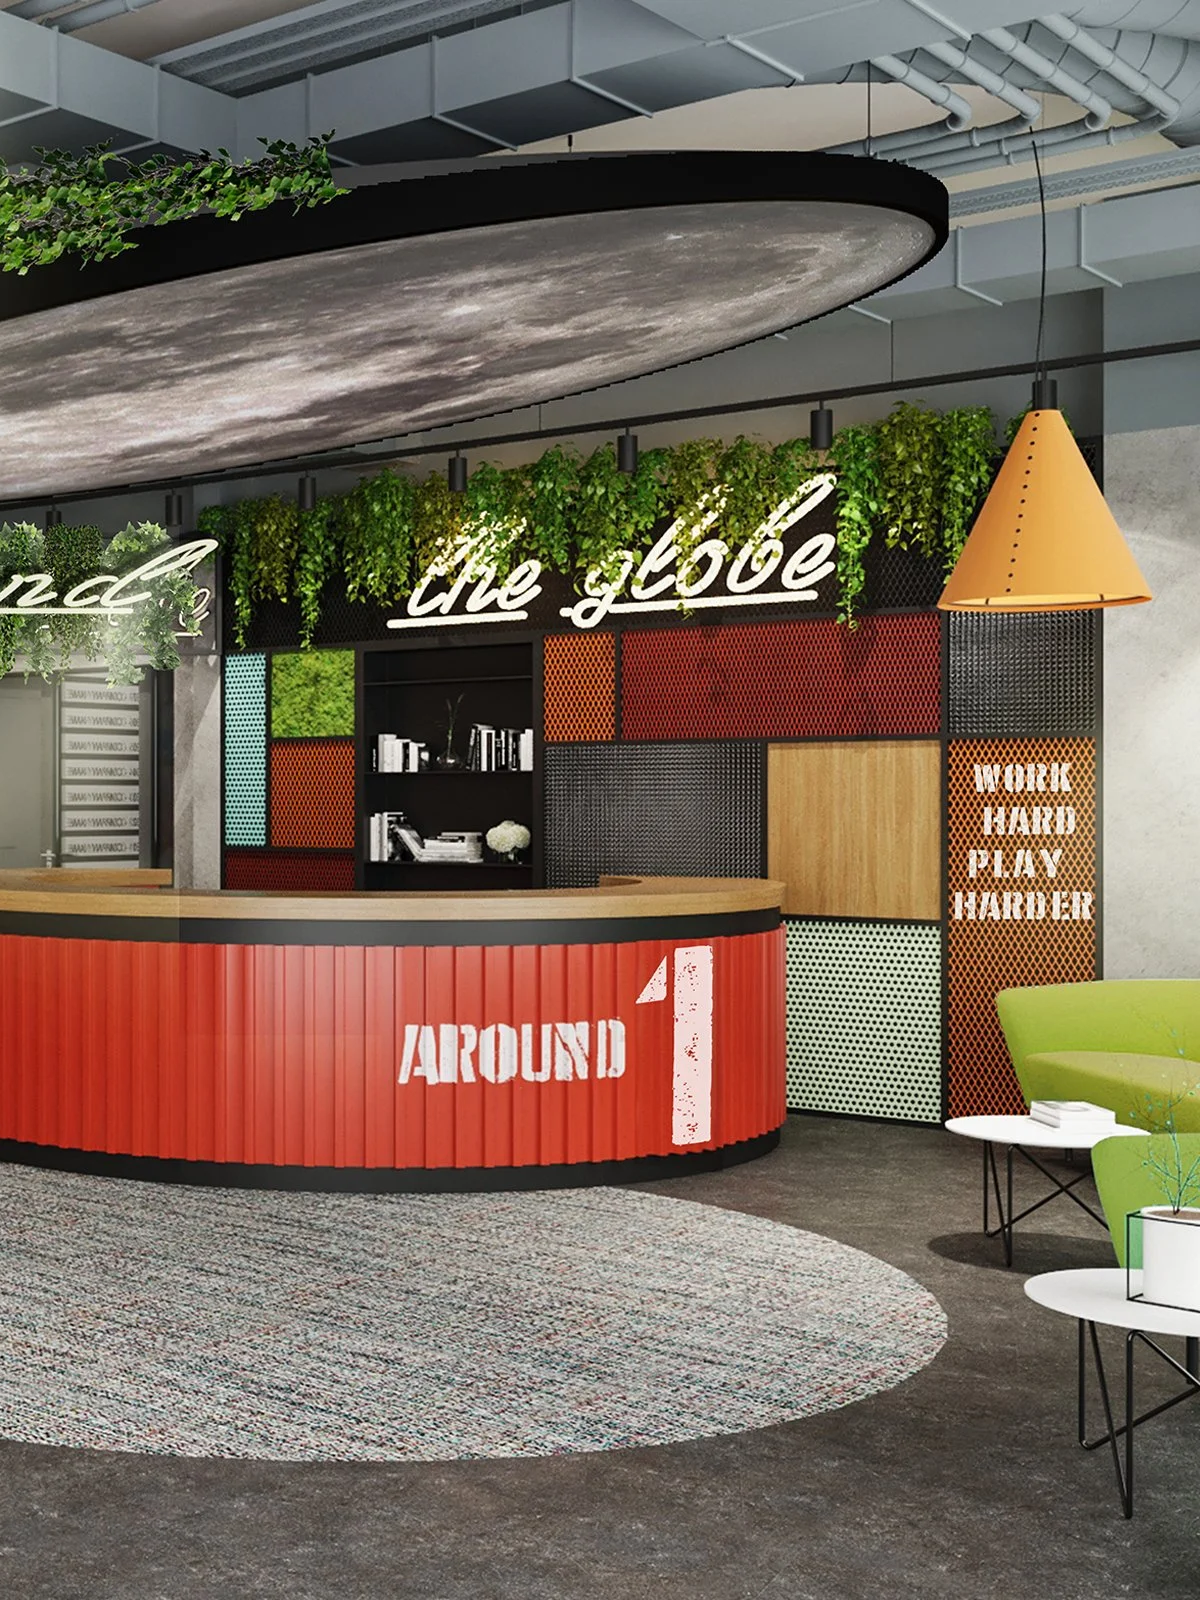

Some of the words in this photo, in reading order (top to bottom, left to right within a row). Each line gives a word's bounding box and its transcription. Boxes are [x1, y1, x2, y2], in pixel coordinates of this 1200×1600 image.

[398, 511, 543, 620] the
[559, 473, 837, 629] globe
[974, 763, 1072, 792] WORK
[983, 807, 1076, 835] HARD
[968, 850, 1062, 878] PLAY
[955, 892, 1092, 920] HARDER
[398, 1019, 626, 1085] AROUND
[635, 945, 713, 1146] 1
